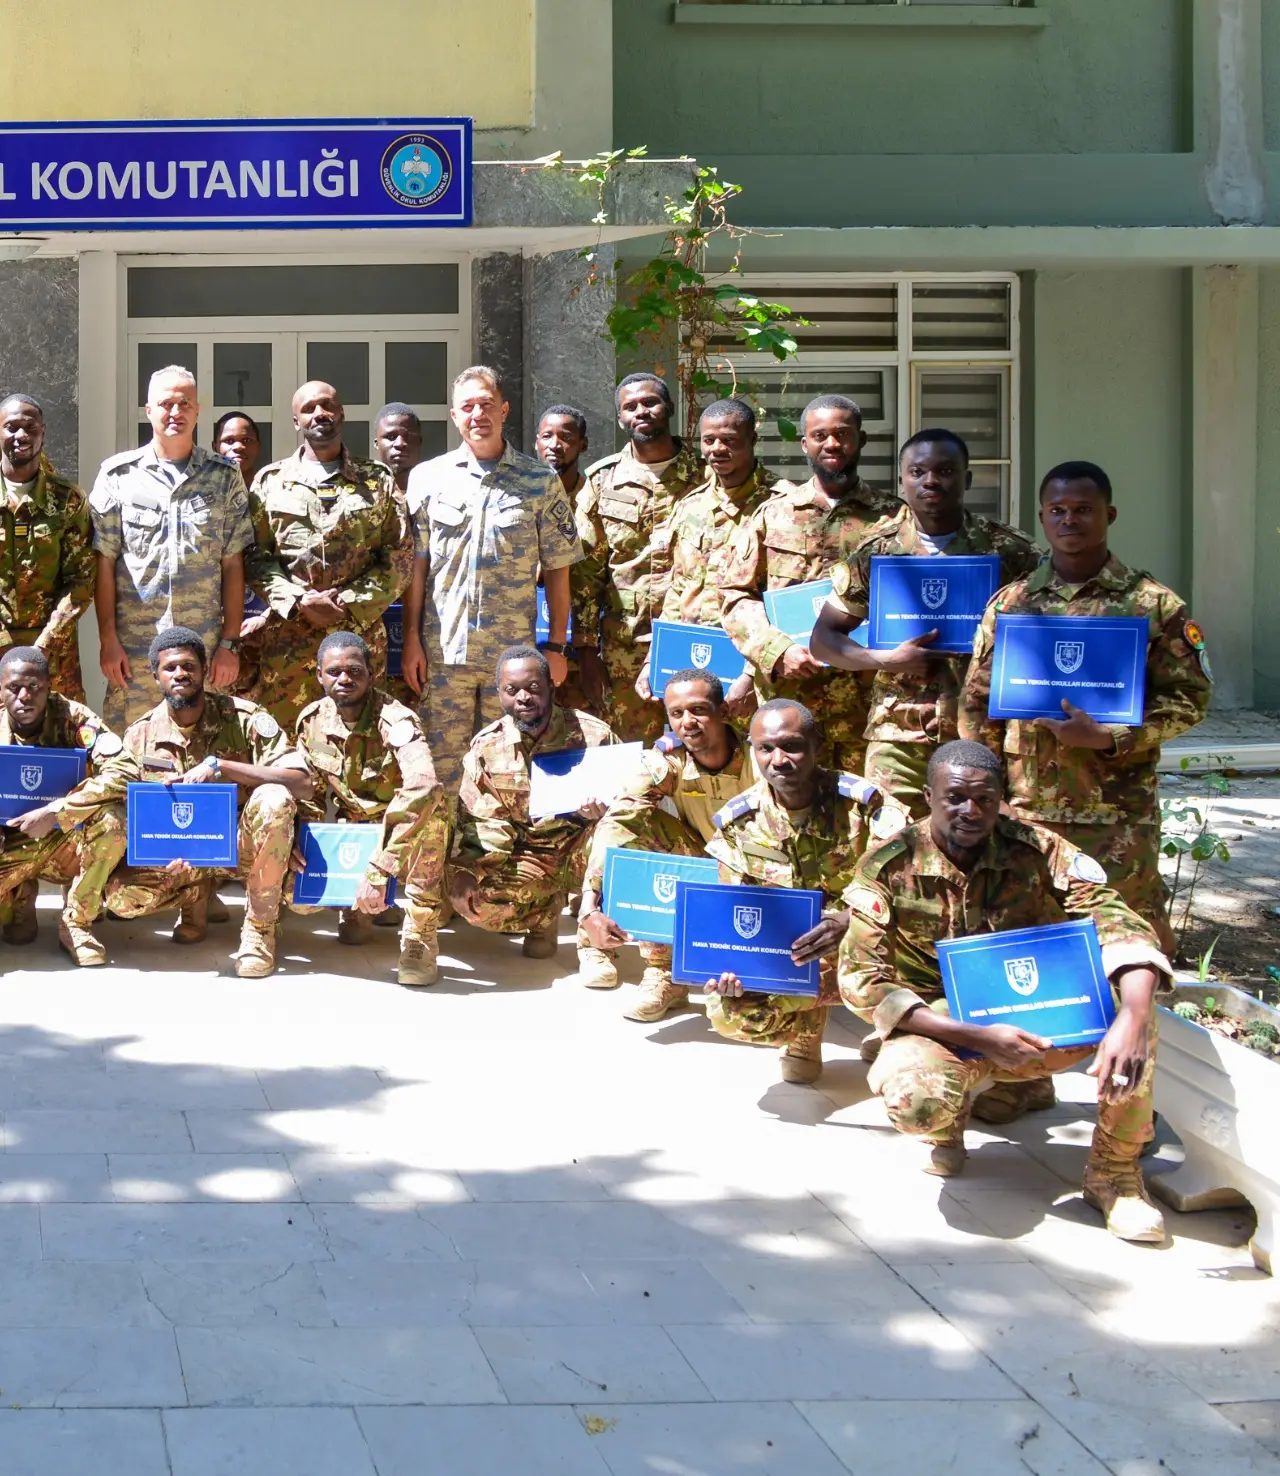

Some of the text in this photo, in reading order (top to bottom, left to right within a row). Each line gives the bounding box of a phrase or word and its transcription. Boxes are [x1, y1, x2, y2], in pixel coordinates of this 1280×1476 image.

[32, 148, 358, 200] KOMUTANLIĞI
[383, 168, 448, 204] GÜVENLİK OKUL KOMUTANLIĞI
[732, 944, 760, 952] OKULLAR
